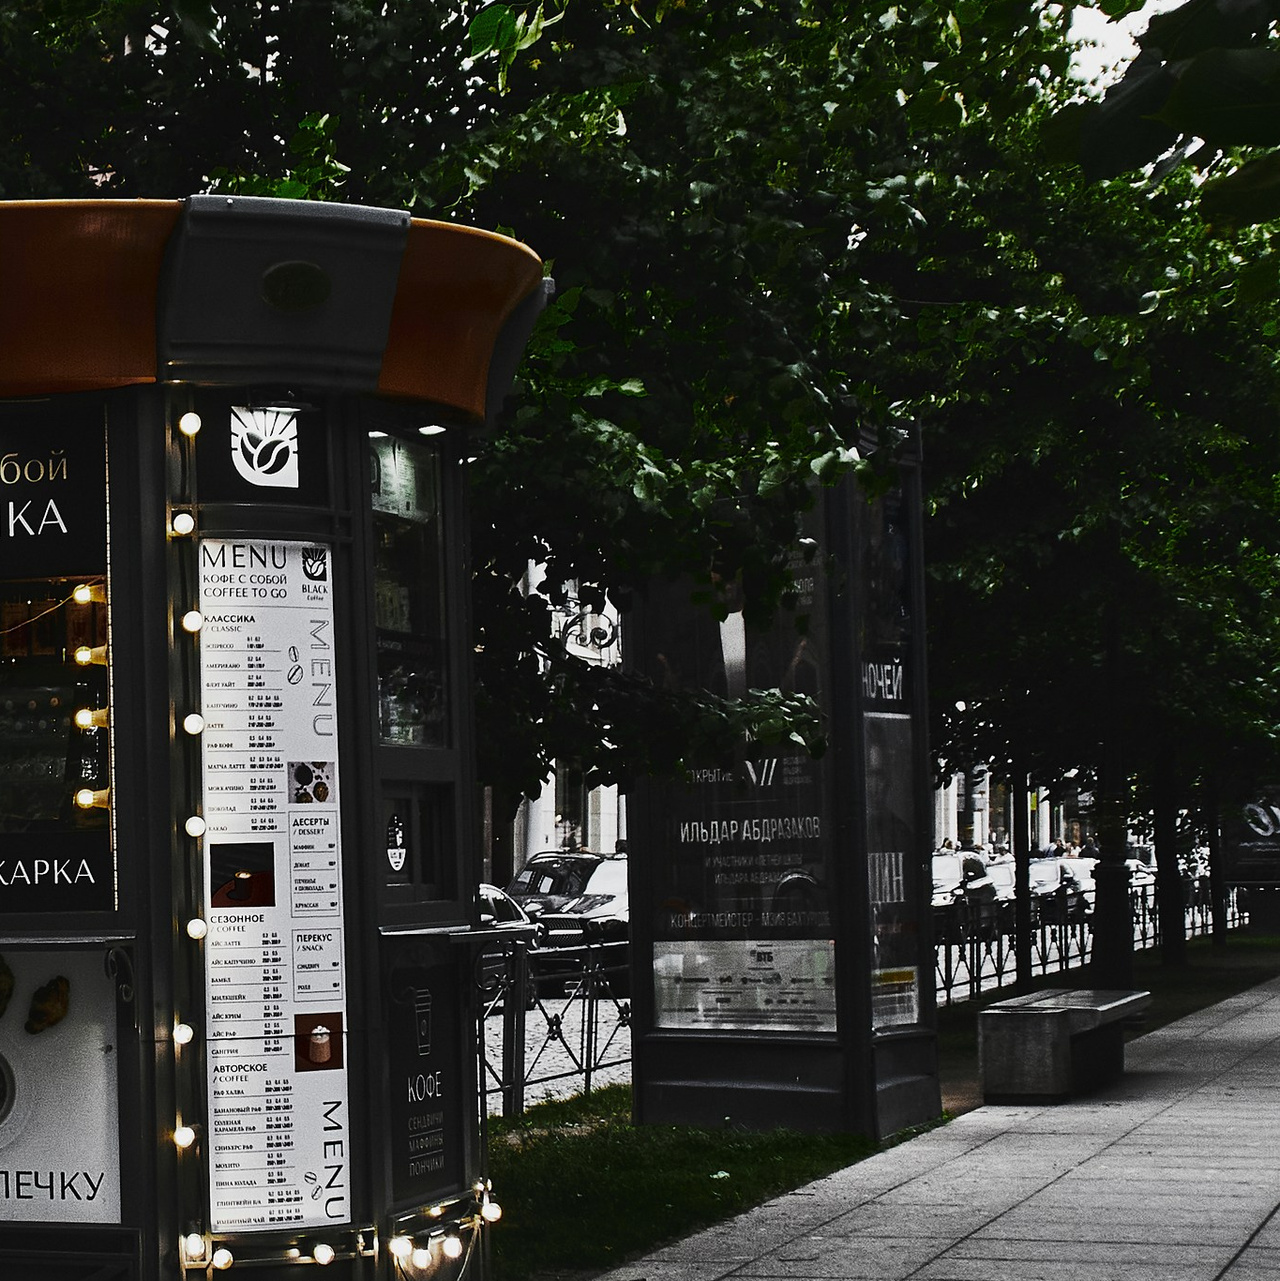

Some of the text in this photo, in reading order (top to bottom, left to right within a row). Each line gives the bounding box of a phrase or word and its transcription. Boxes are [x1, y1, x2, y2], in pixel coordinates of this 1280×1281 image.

[202, 544, 287, 569] MENU
[203, 573, 287, 585] КОФЕ С СОБОЙ
[204, 588, 287, 599] COFFEE TO GO
[302, 584, 328, 595] BLACK
[204, 615, 256, 623] КЛАССИКА
[310, 620, 333, 736] MENU
[862, 657, 902, 700] НОЧЕЙ
[292, 818, 330, 827] ДЕСЕРТЫ
[680, 816, 820, 845] ИЛЬДАР АБДРАЗАКОВ
[211, 914, 265, 923] СЕЗОННОЕ
[670, 910, 753, 928] КОНЦЕРТМЕЙСТЕР
[296, 934, 333, 942] ПЕРЕКУС
[213, 1064, 268, 1073] АВТОРСКОЕ
[407, 1070, 442, 1103] КОФЕ
[408, 1111, 444, 1131] СЕНДВИЧИ
[408, 1132, 444, 1152] МАФФИНЫ
[322, 1101, 345, 1218] MENU
[409, 1157, 445, 1177] ПОНЧИКИ
